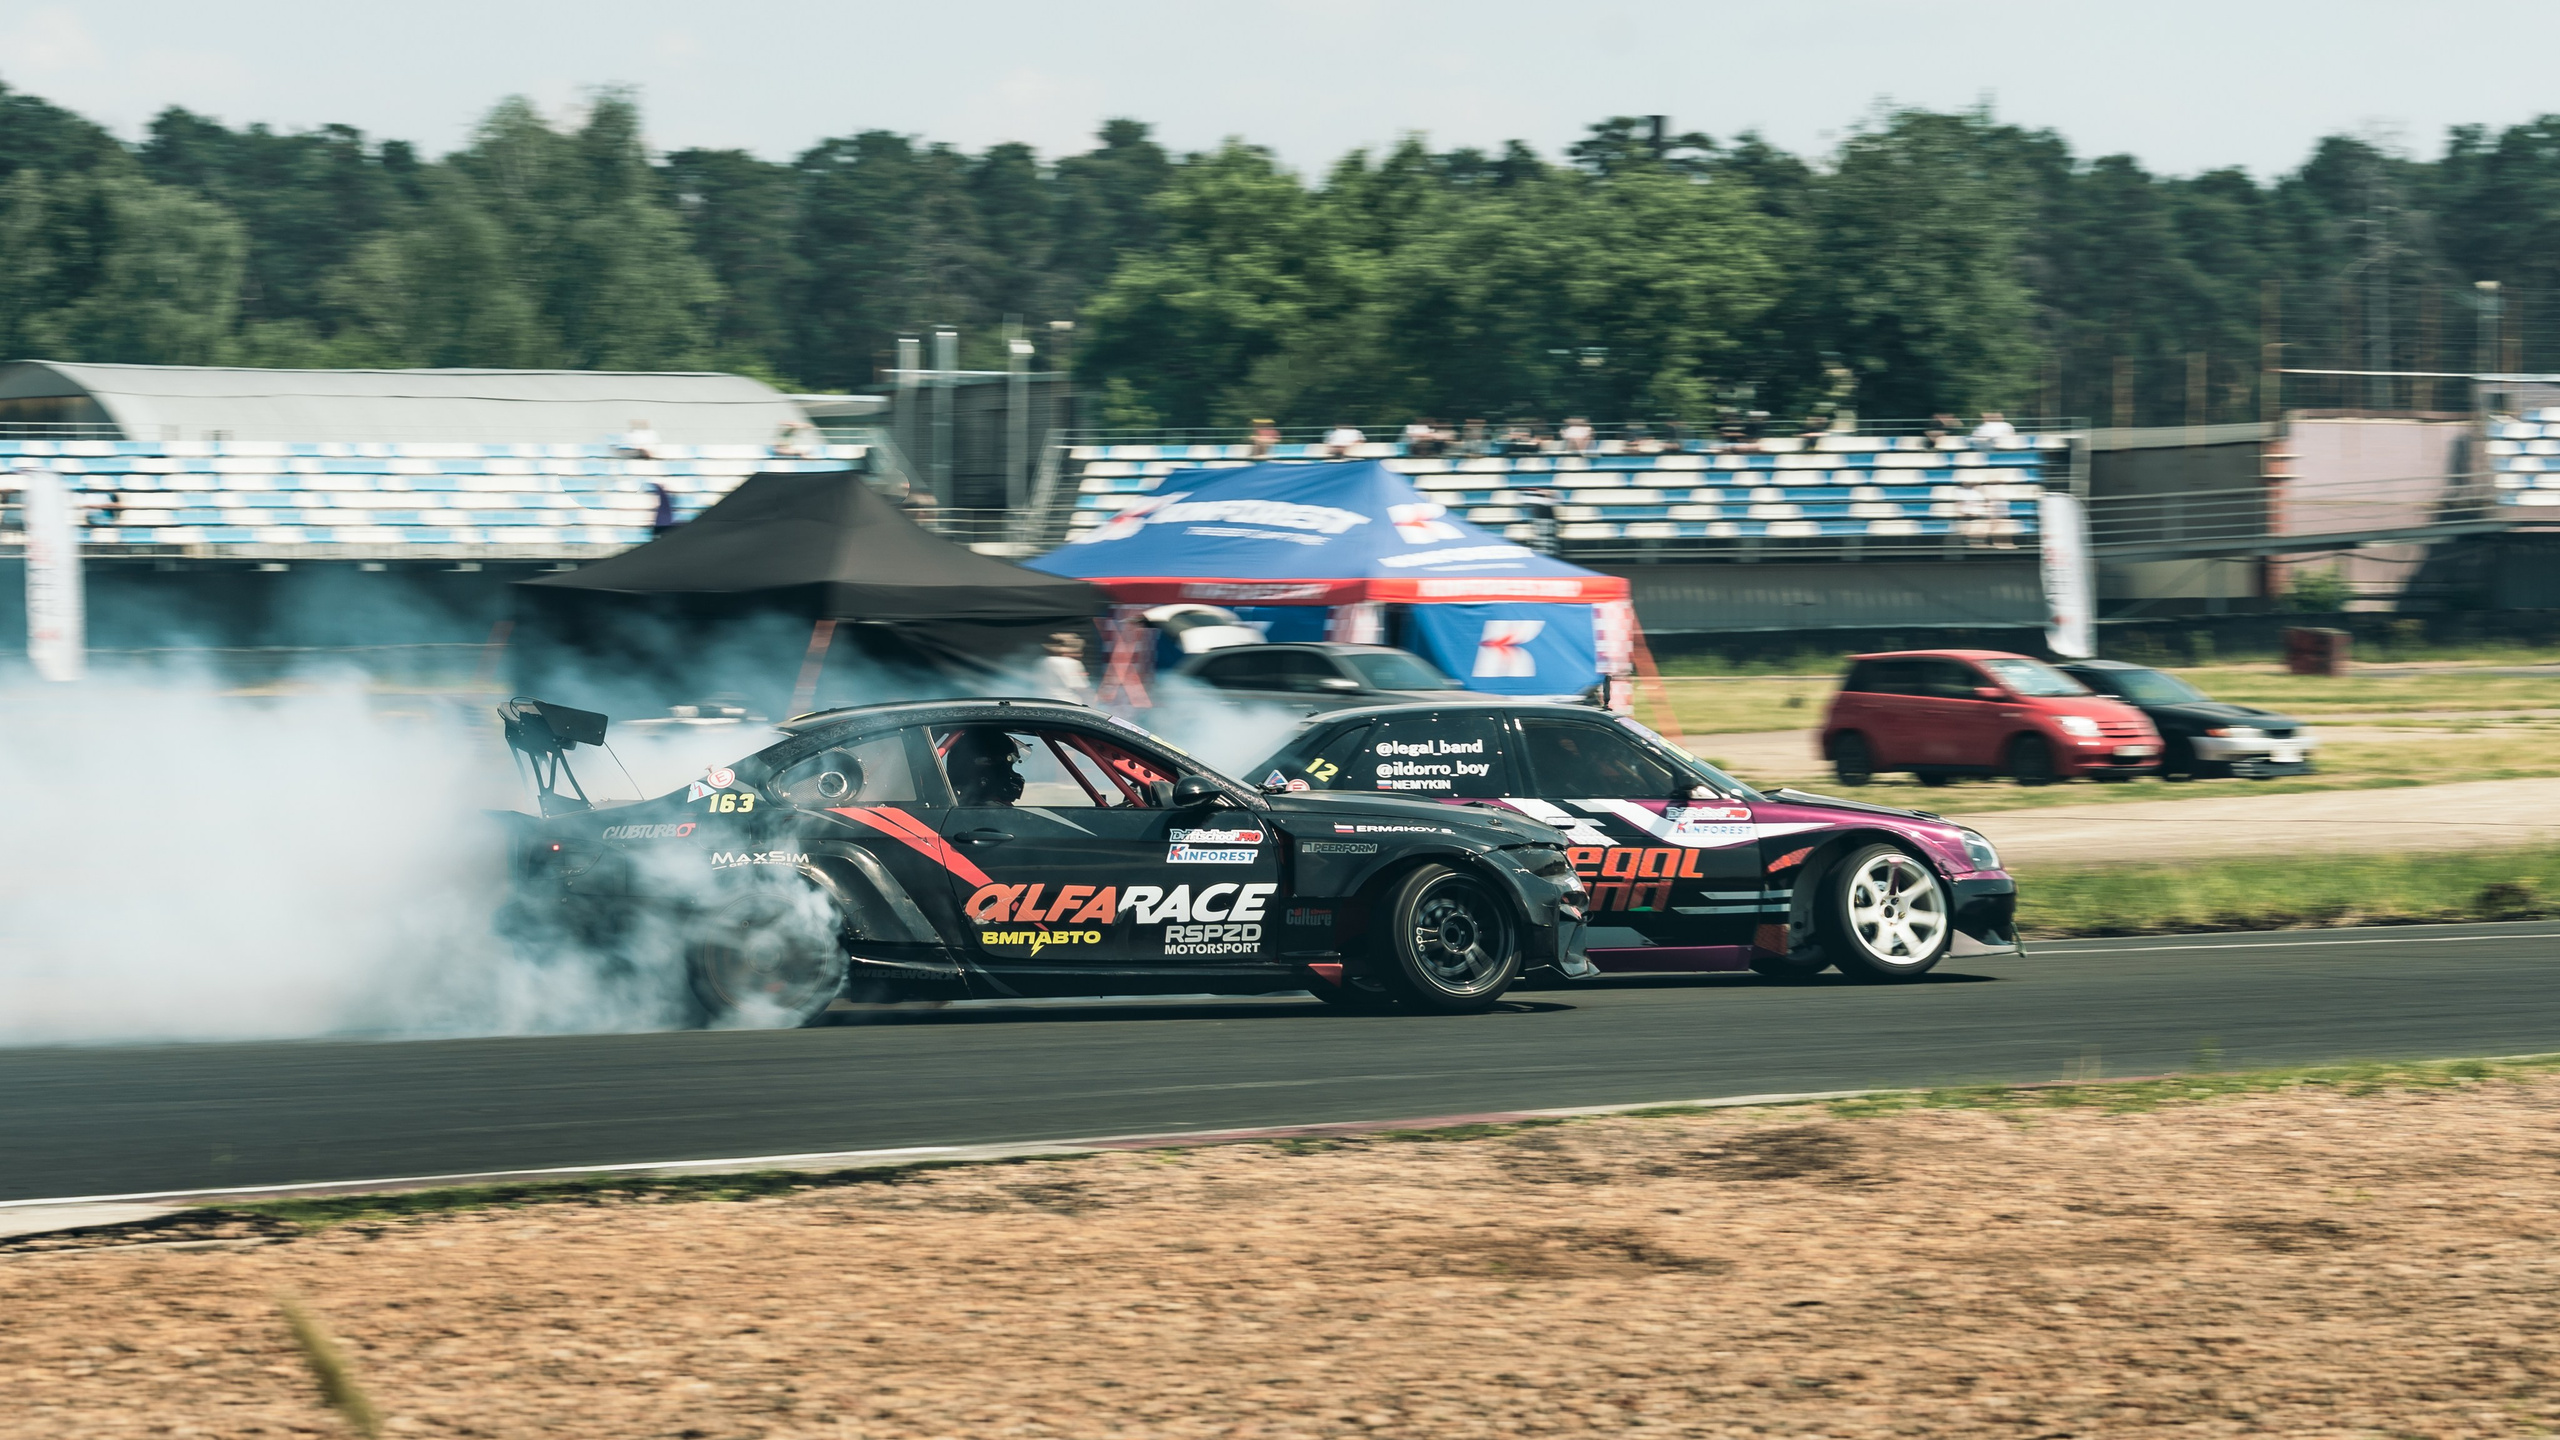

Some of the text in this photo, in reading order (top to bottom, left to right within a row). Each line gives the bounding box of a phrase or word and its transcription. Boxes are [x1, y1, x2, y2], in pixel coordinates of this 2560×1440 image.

[1375, 739, 1483, 757] @legal_band
[1305, 757, 1339, 783] 12
[1376, 761, 1490, 777] @ildorro_boy
[715, 772, 727, 783] E
[1392, 780, 1451, 790] NEMYKIN
[708, 793, 755, 813] 163
[1356, 825, 1437, 833] ERMAKOV
[1170, 845, 1255, 861] KINFOREST
[1165, 943, 1261, 955] MOTORSPORT
